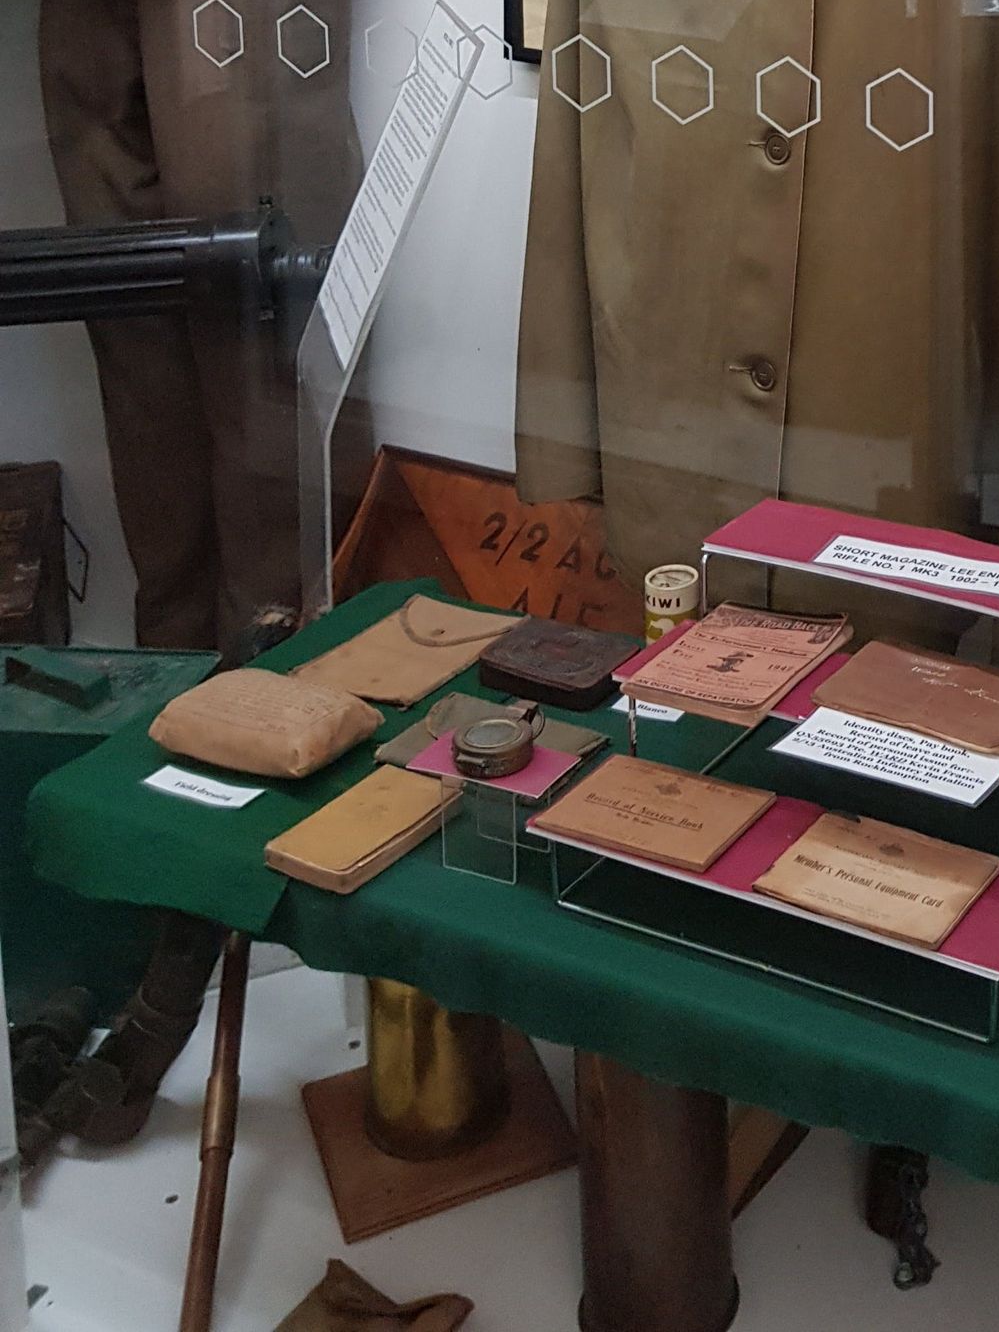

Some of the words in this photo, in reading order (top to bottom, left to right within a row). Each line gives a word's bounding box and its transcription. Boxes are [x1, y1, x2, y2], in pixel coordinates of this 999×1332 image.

[480, 512, 550, 566] 2/2
[832, 552, 871, 565] RIFLE
[872, 560, 893, 570] NO.
[911, 566, 940, 577] MK3
[950, 575, 979, 584] 1902
[833, 544, 880, 558] SHORT
[880, 554, 949, 571] MAGAZINE
[949, 566, 976, 576] LEE
[760, 619, 791, 629] ROAD
[637, 704, 668, 714] Blanco
[817, 729, 857, 743] Record
[857, 738, 871, 747] of
[869, 744, 919, 758] personal
[919, 754, 948, 766] issue
[843, 720, 886, 736] Identity
[887, 731, 916, 744] discs,
[919, 739, 940, 750] Pay
[941, 744, 970, 758] book,
[849, 729, 889, 744] Record
[889, 739, 904, 748] of
[902, 743, 931, 755] leave
[932, 752, 955, 761] and
[817, 743, 874, 762] Australian
[876, 758, 924, 775] Infantry
[924, 771, 975, 789] Battalion
[823, 751, 851, 762] from
[852, 759, 930, 784] Rockhampton
[846, 744, 867, 753] Pte.
[869, 750, 908, 764] WARD
[908, 760, 940, 773] Kevin
[943, 770, 985, 784] Francis
[793, 854, 834, 874] Member's
[835, 868, 874, 887] Personal
[875, 881, 920, 901] Equipment
[921, 895, 945, 908] Card
